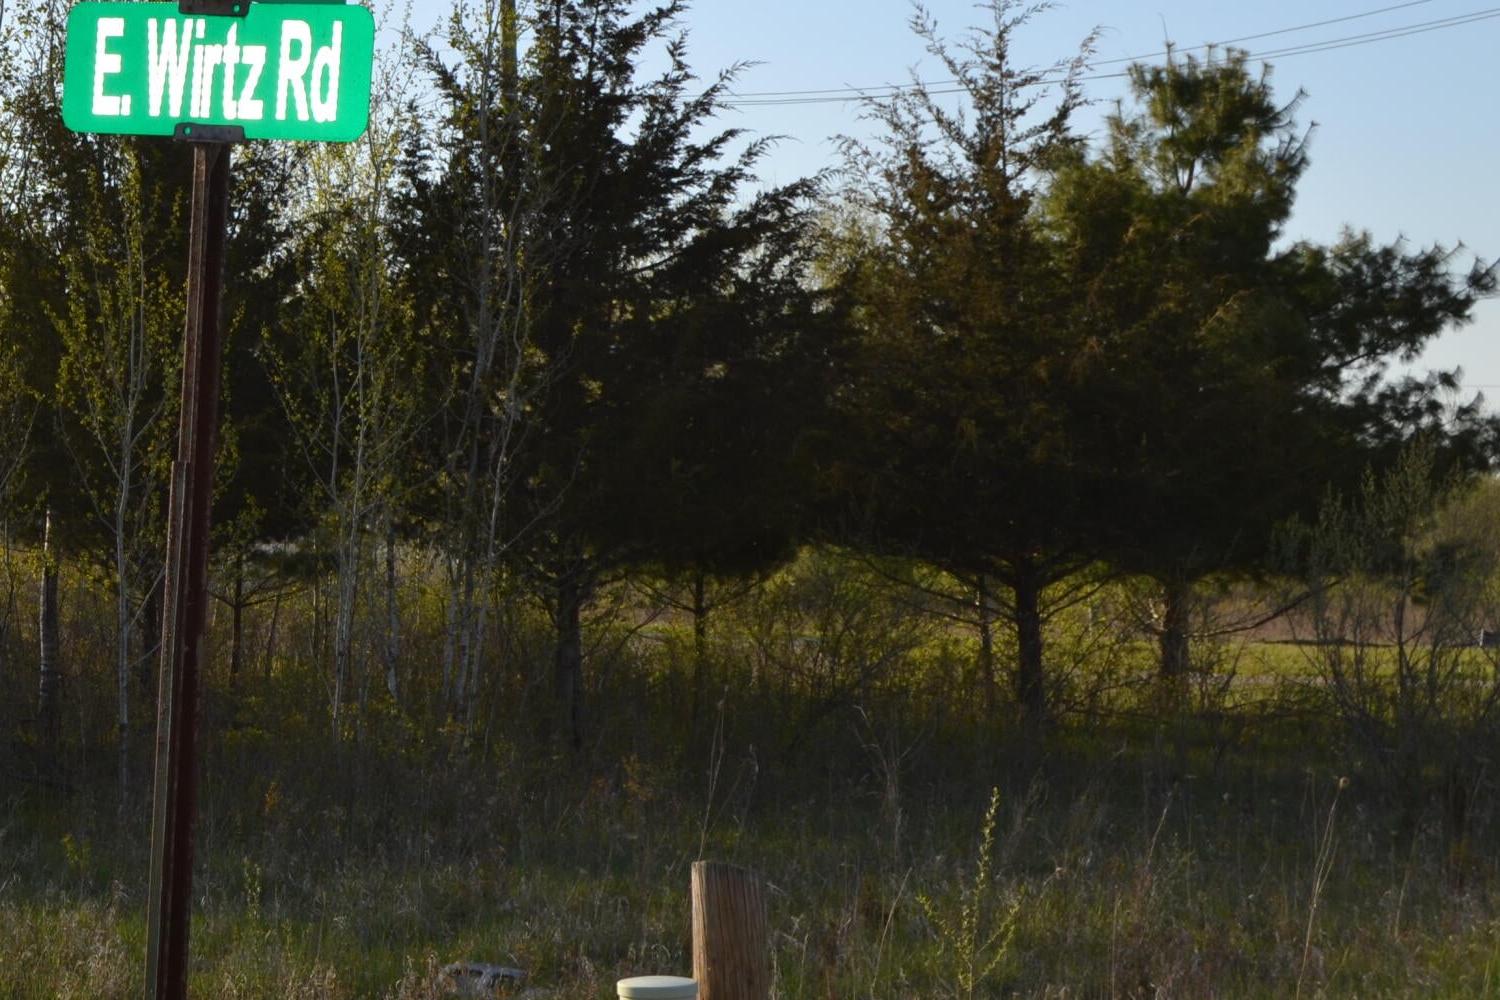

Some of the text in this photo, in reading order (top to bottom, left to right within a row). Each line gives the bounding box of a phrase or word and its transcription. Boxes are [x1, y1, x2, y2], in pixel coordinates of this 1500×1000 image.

[92, 17, 342, 123] E. Wirtz Rd
